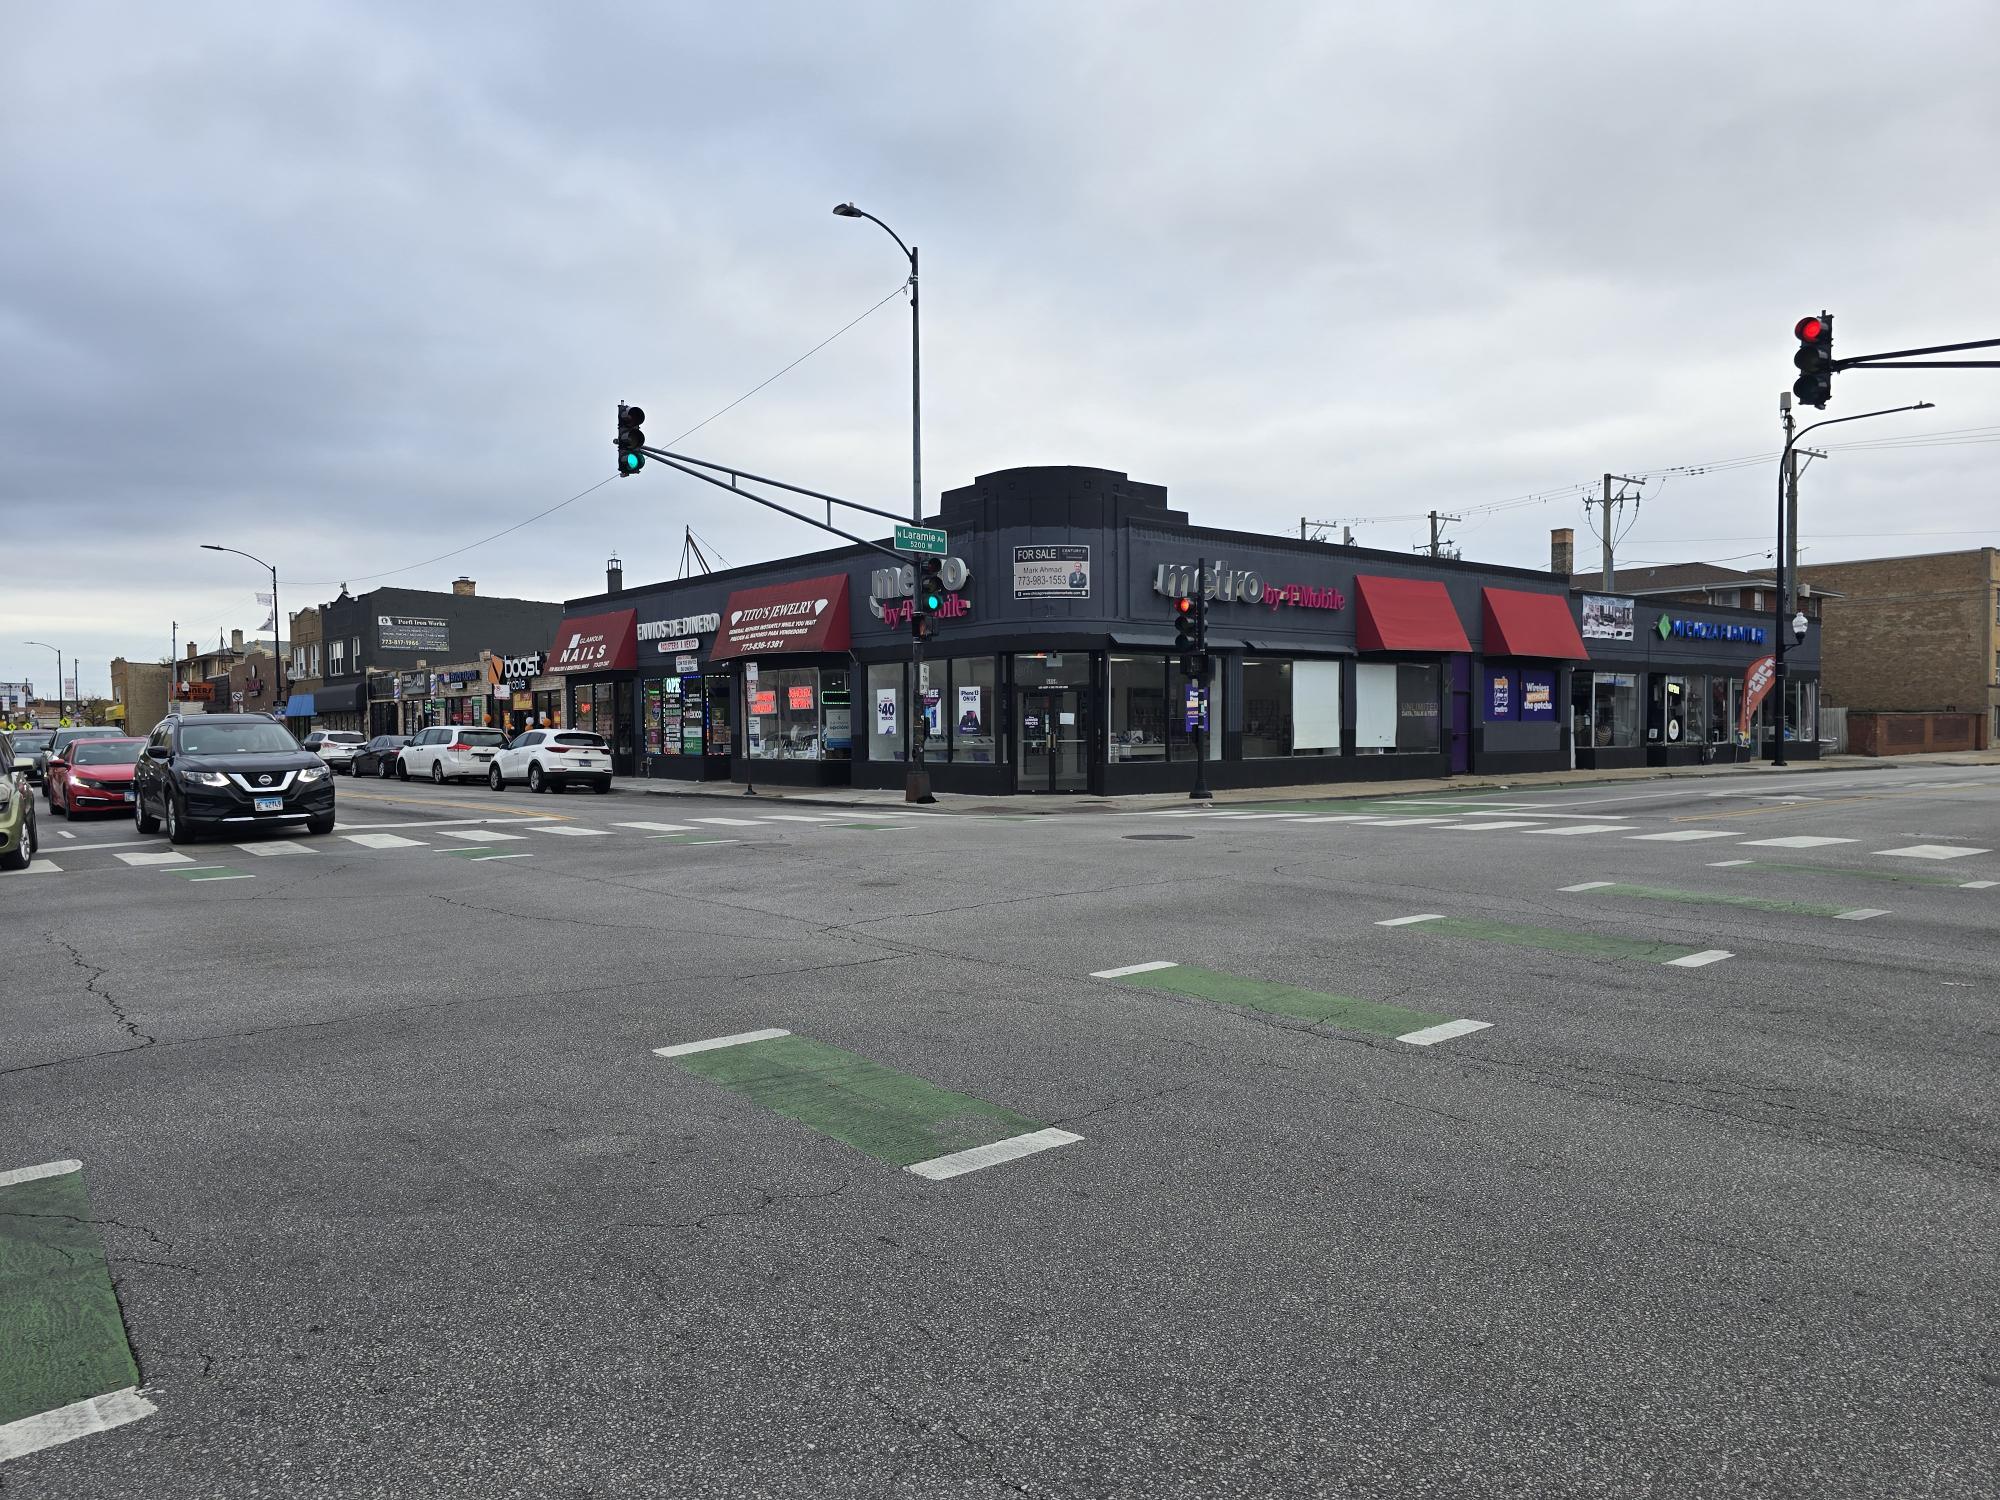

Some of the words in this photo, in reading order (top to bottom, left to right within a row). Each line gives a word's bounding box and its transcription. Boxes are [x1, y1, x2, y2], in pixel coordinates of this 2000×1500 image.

[903, 529, 936, 541] Laramie
[910, 541, 925, 549] 5200
[1017, 549, 1034, 560] FOR
[1035, 548, 1057, 559] SALE
[1017, 574, 1067, 586] 773-983-1553
[1156, 560, 1264, 603] metro
[1263, 582, 1281, 611] by
[1284, 584, 1346, 611] T-Mobile
[742, 606, 770, 622] TITO'S
[768, 600, 814, 621] JEWELRY
[883, 604, 899, 631] by
[637, 620, 668, 641] ENVIOS
[669, 619, 683, 637] DE
[683, 612, 720, 635] DINERO
[1673, 619, 1684, 637] MI
[1685, 620, 1719, 640] CHOZA
[1719, 623, 1768, 644] FURNITURE
[579, 634, 604, 645] GLAMOUR
[560, 644, 607, 663] NAILS
[504, 650, 540, 679] boost
[507, 680, 526, 690] mobile
[1526, 683, 1550, 692] Wireless
[878, 702, 895, 716] $40
[1401, 702, 1439, 710] UNLIMITED
[1524, 701, 1534, 710] the
[1533, 700, 1552, 711] gotcha
